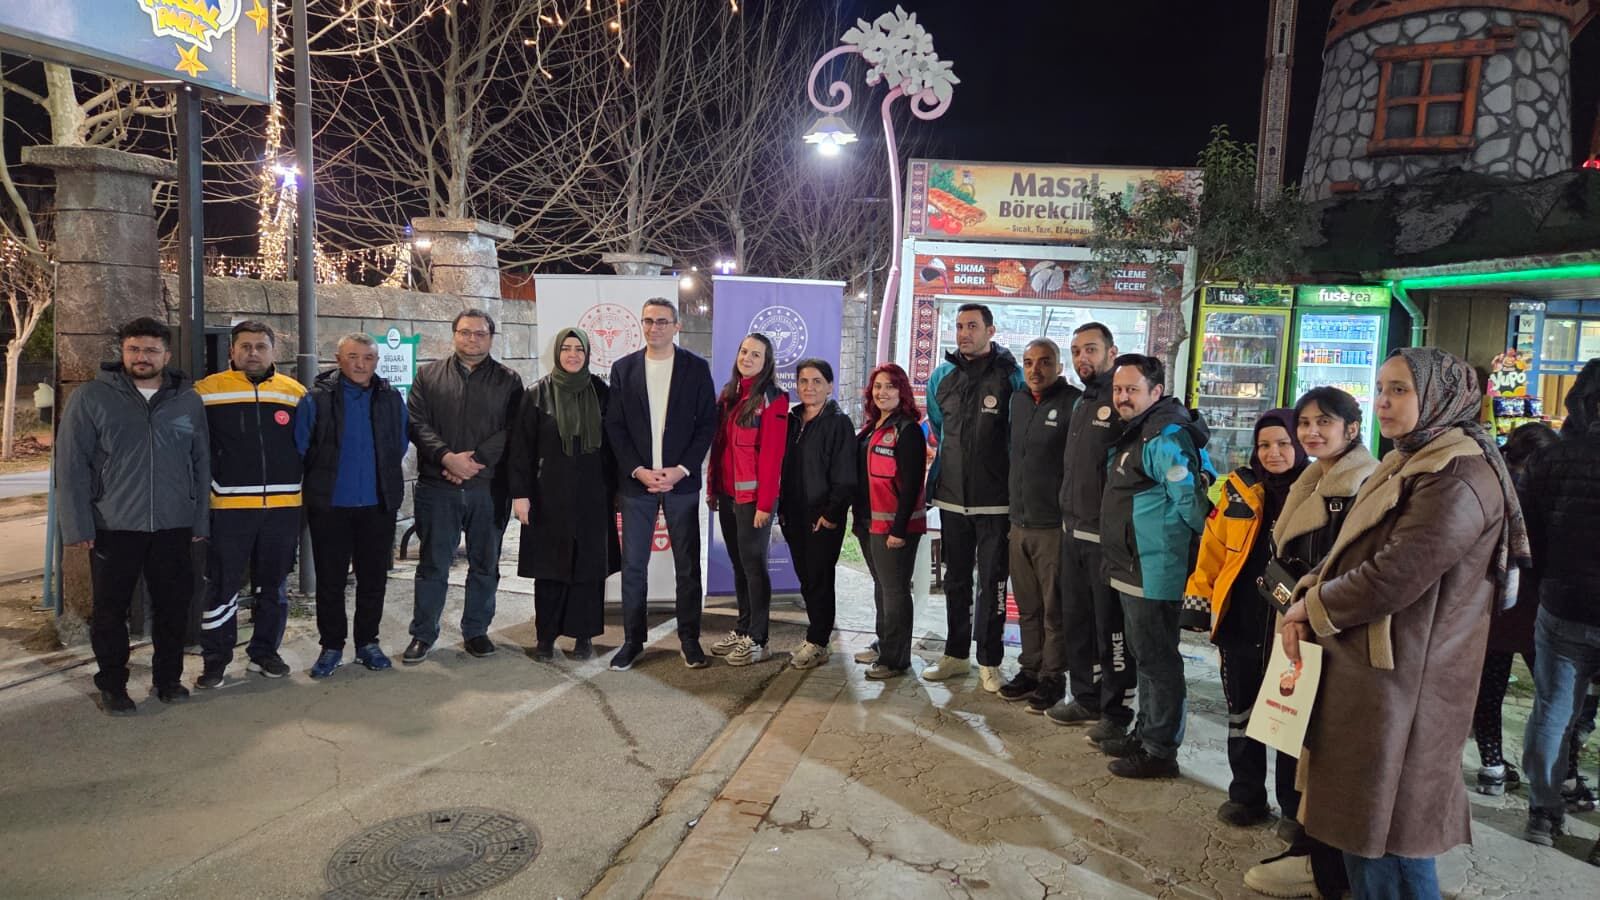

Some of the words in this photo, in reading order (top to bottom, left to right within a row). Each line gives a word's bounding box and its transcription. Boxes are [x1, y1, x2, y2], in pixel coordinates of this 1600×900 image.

[157, 6, 208, 42] PARK
[1010, 172, 1100, 198] Masal
[953, 273, 985, 285] BÖREK
[954, 263, 985, 273] SIKMA
[1111, 631, 1124, 672] UMKE
